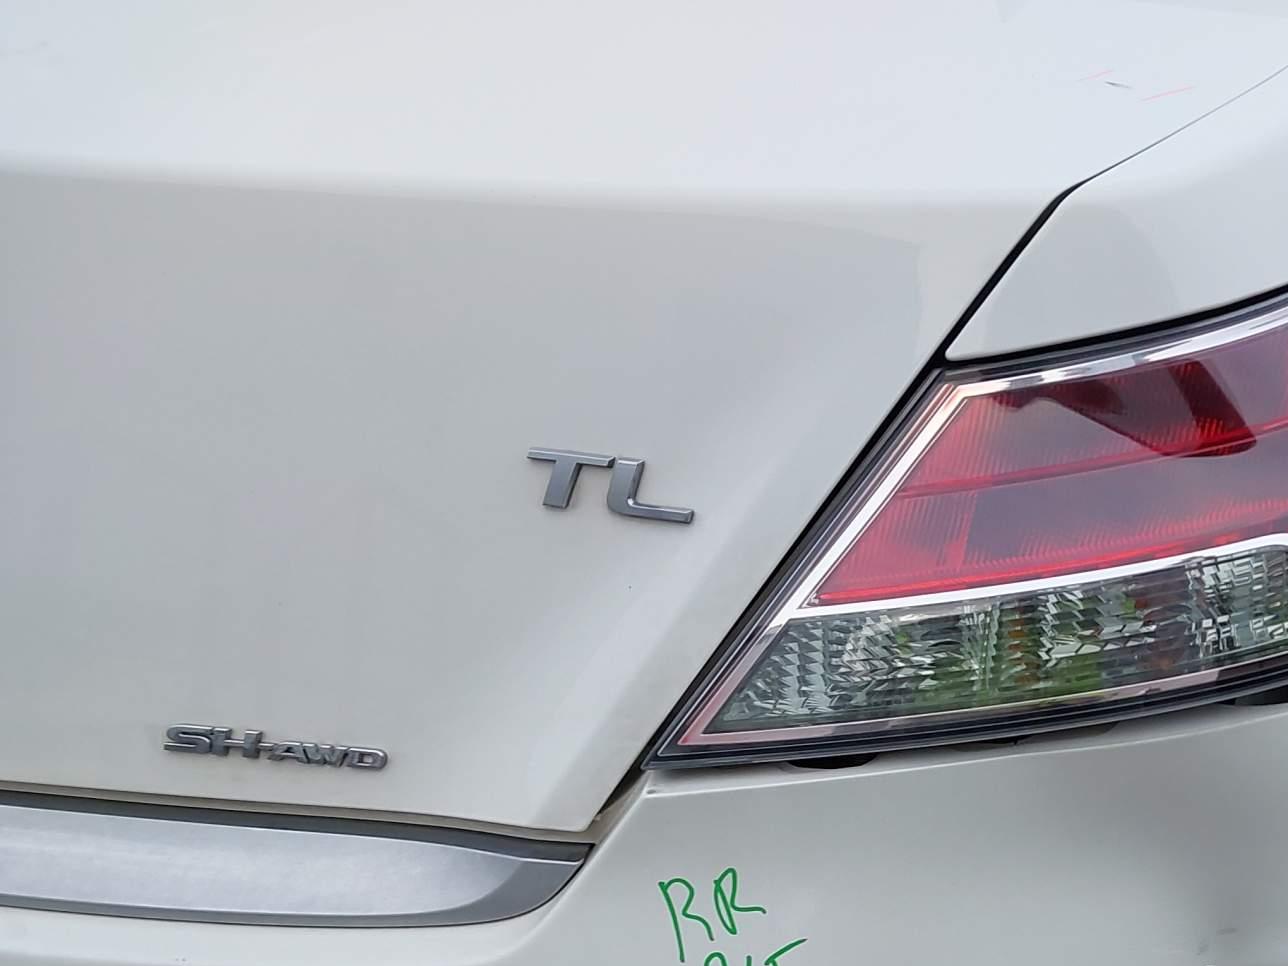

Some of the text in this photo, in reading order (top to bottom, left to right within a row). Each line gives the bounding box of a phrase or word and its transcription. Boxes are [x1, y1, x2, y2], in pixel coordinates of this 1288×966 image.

[527, 447, 695, 524] TL
[163, 723, 388, 770] SH-AWD
[658, 867, 767, 963] RR
